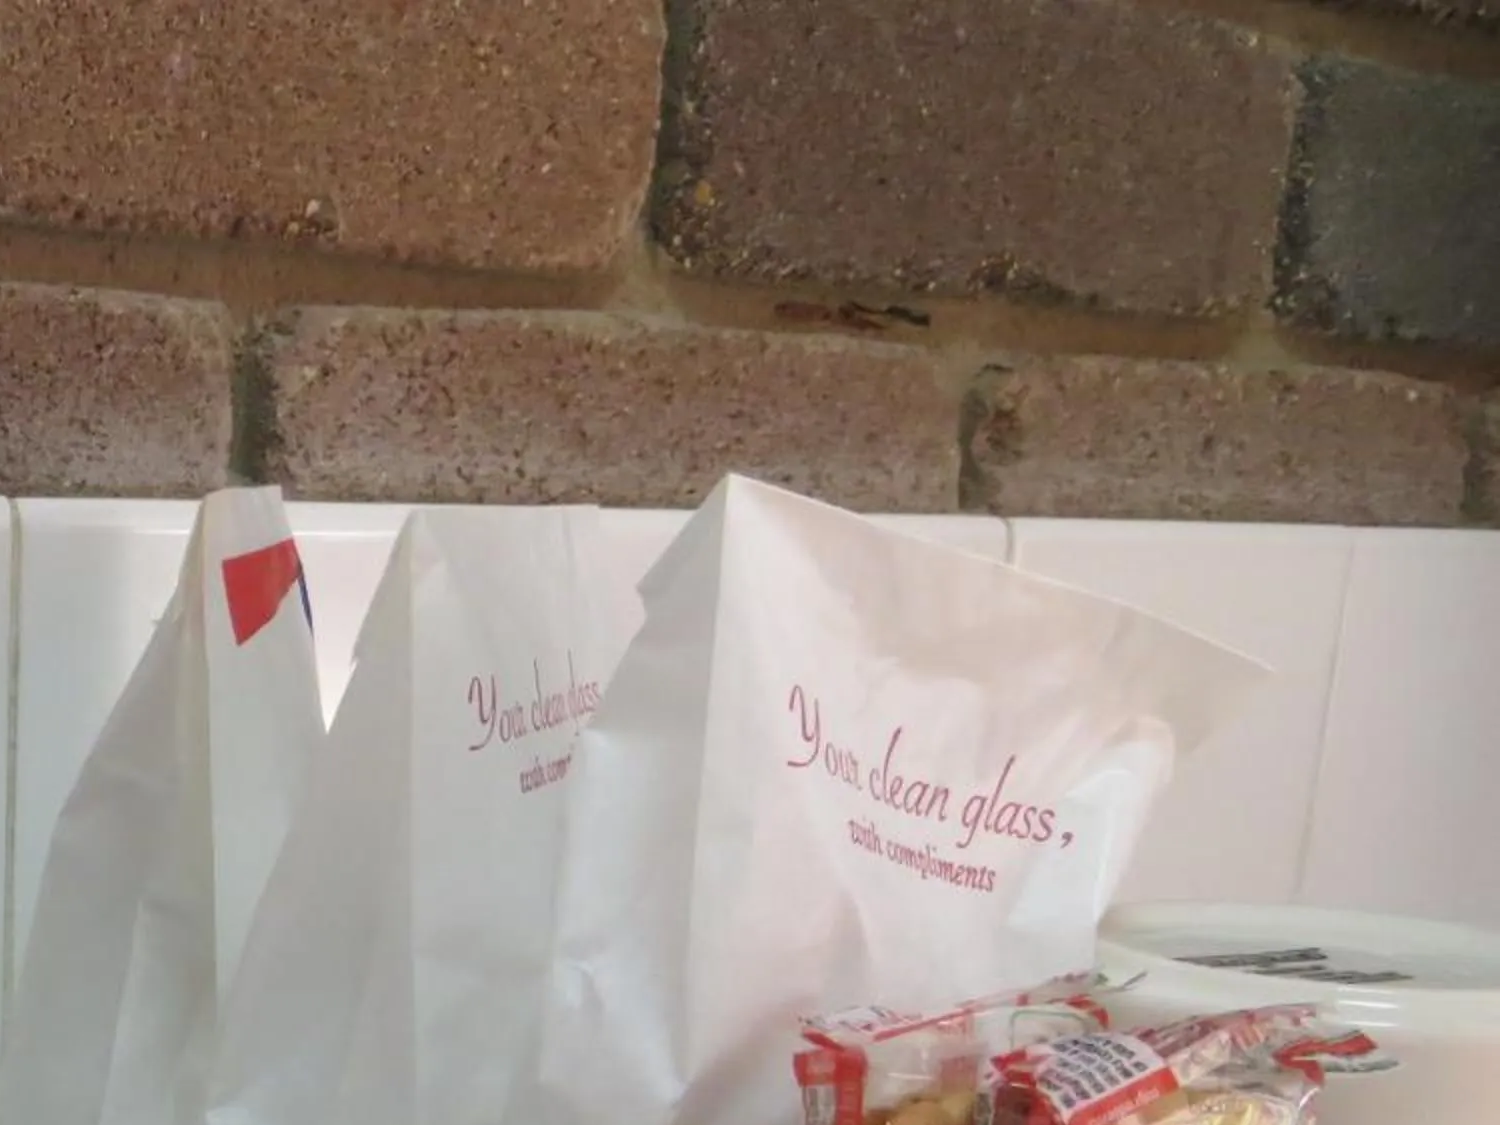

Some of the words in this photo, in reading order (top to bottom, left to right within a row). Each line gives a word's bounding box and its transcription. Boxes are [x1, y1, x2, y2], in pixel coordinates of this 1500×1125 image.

[467, 675, 527, 751] Your
[786, 684, 863, 791] Your
[868, 726, 951, 823] clean
[956, 754, 1075, 850] glass,
[847, 817, 883, 856] with
[886, 844, 997, 894] compliments
